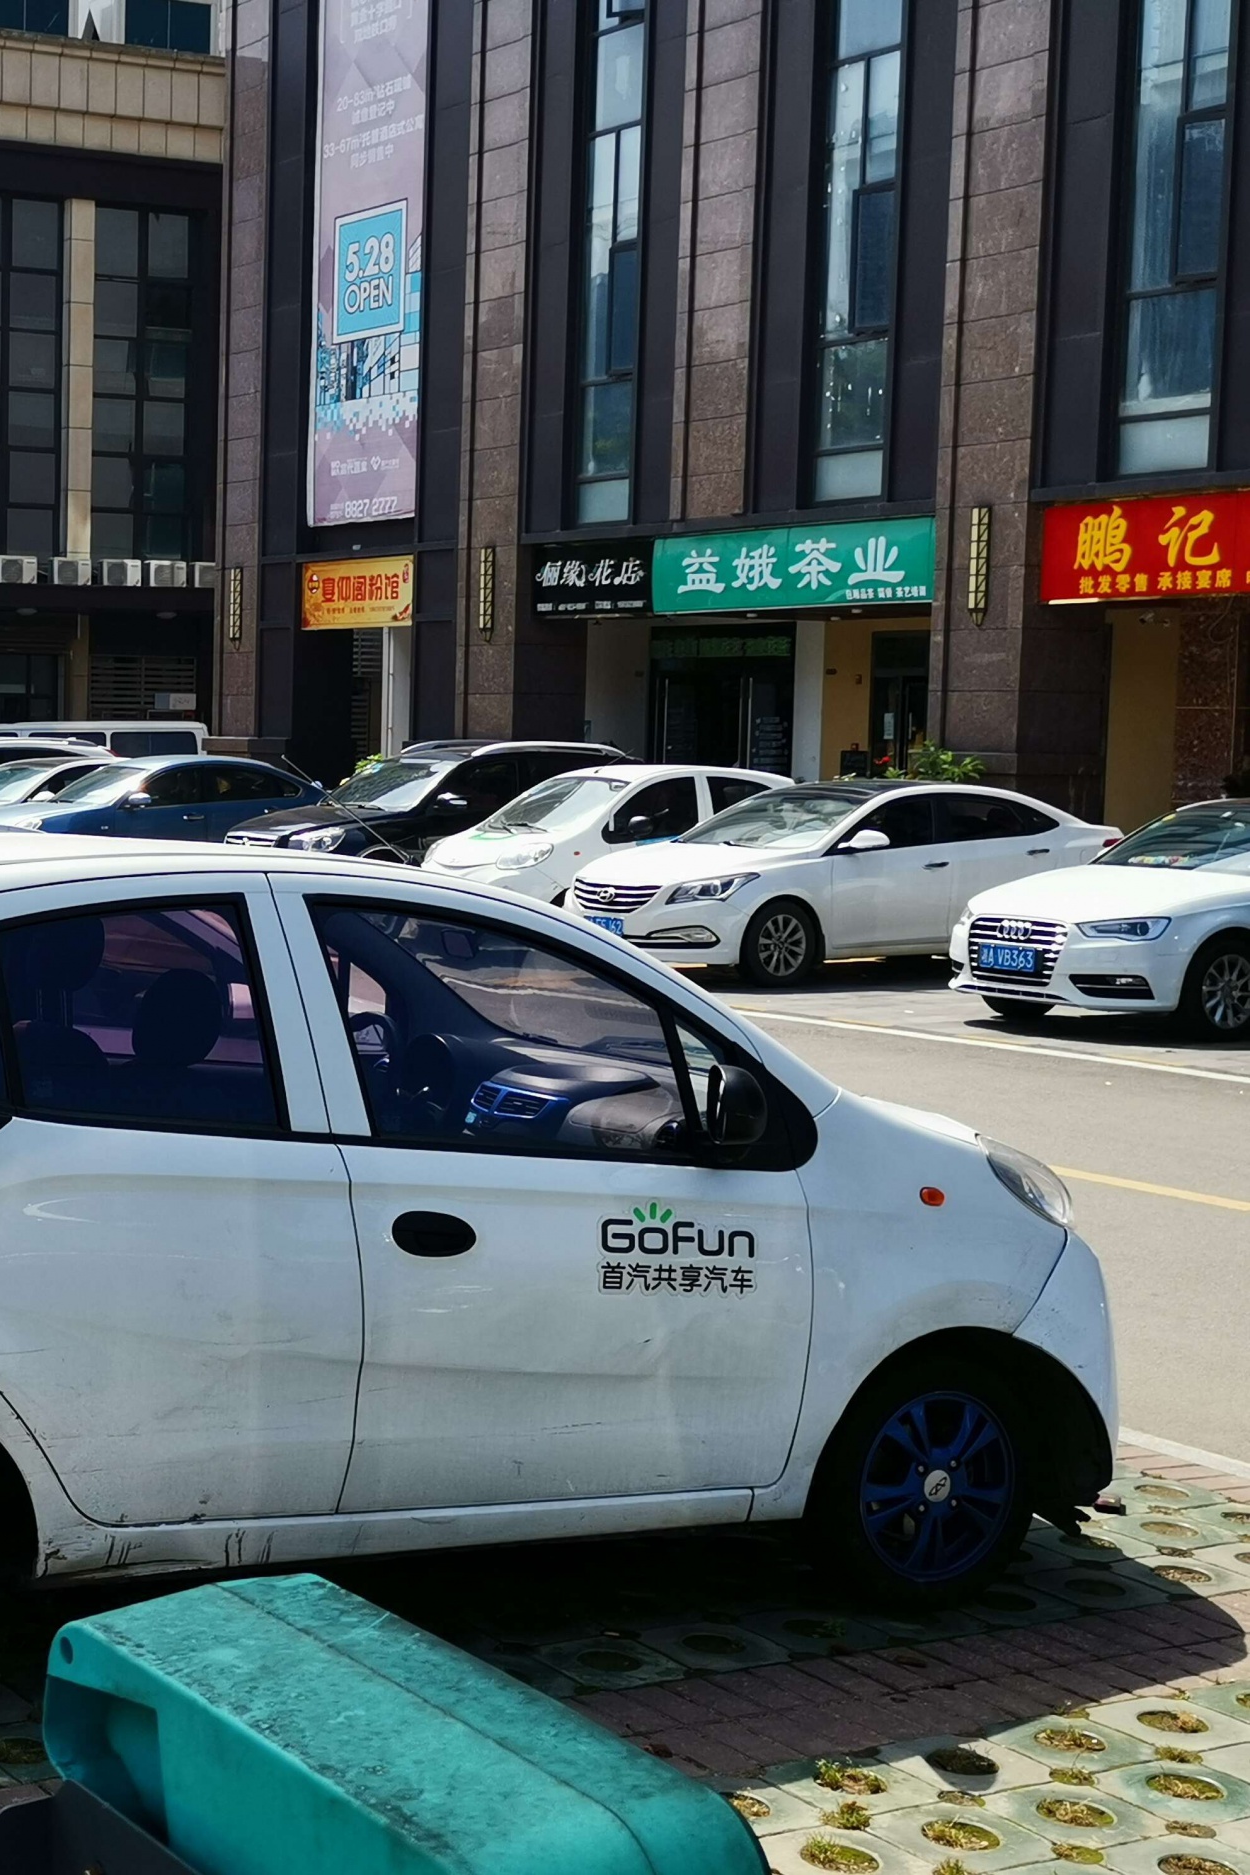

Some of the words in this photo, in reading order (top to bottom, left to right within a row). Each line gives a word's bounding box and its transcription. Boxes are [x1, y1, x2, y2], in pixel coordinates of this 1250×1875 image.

[344, 231, 395, 282] 5.28
[343, 274, 393, 315] OPEN
[345, 499, 370, 518] 8827
[371, 496, 398, 516] 2777
[1073, 505, 1221, 572] 鹏记
[677, 535, 906, 594] 益娥茶业
[1079, 573, 1148, 594] 批发零售
[1157, 568, 1232, 591] 承接宴席
[601, 1217, 755, 1258] GoFun
[601, 1261, 754, 1294] 首汽共享汽车
